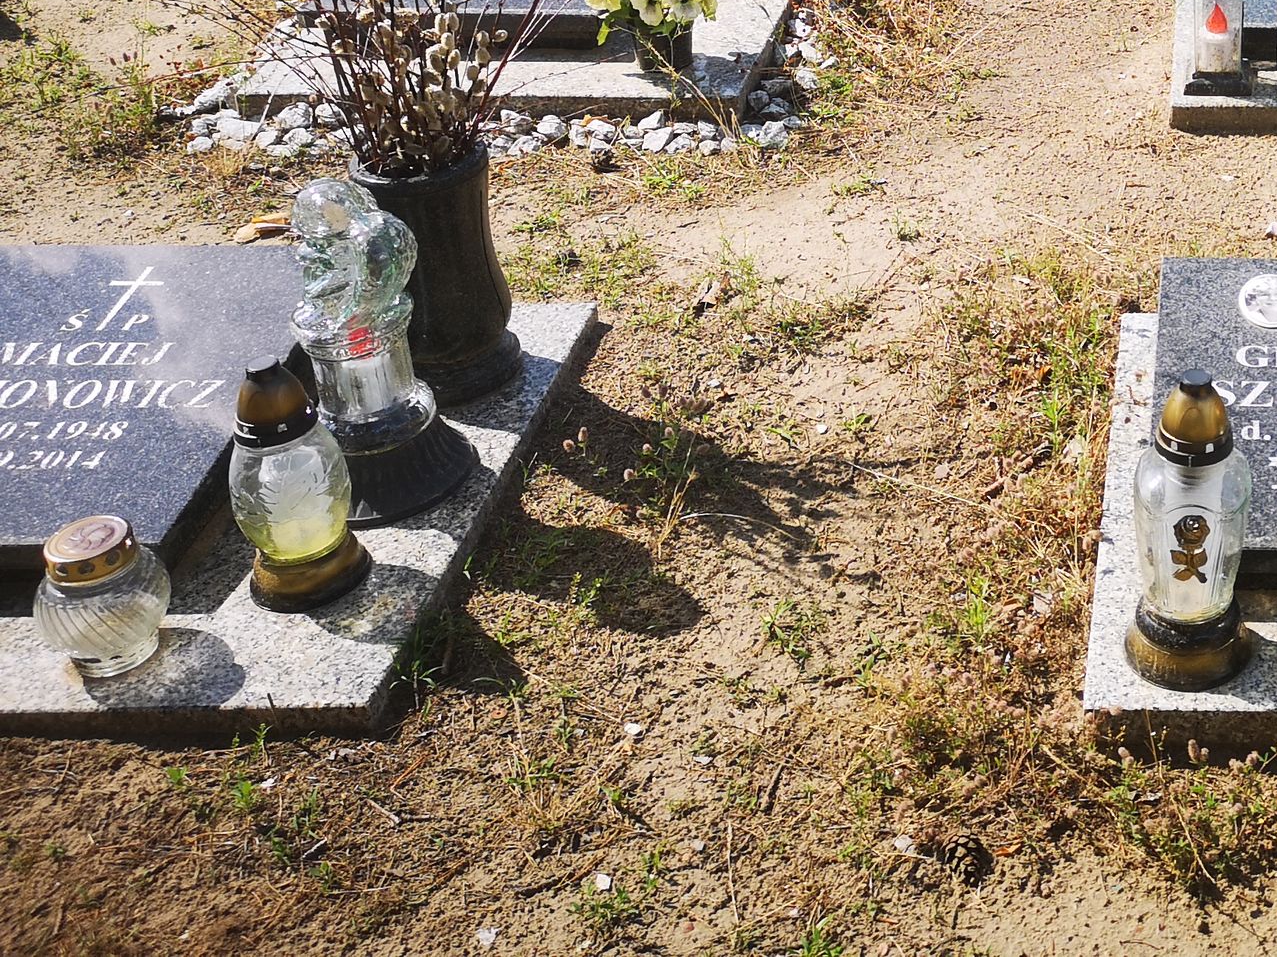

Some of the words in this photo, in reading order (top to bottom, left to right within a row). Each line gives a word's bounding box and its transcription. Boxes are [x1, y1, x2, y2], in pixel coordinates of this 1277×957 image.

[60, 309, 91, 332] Ś
[121, 314, 150, 331] P
[0, 379, 226, 409] ONOWICZ
